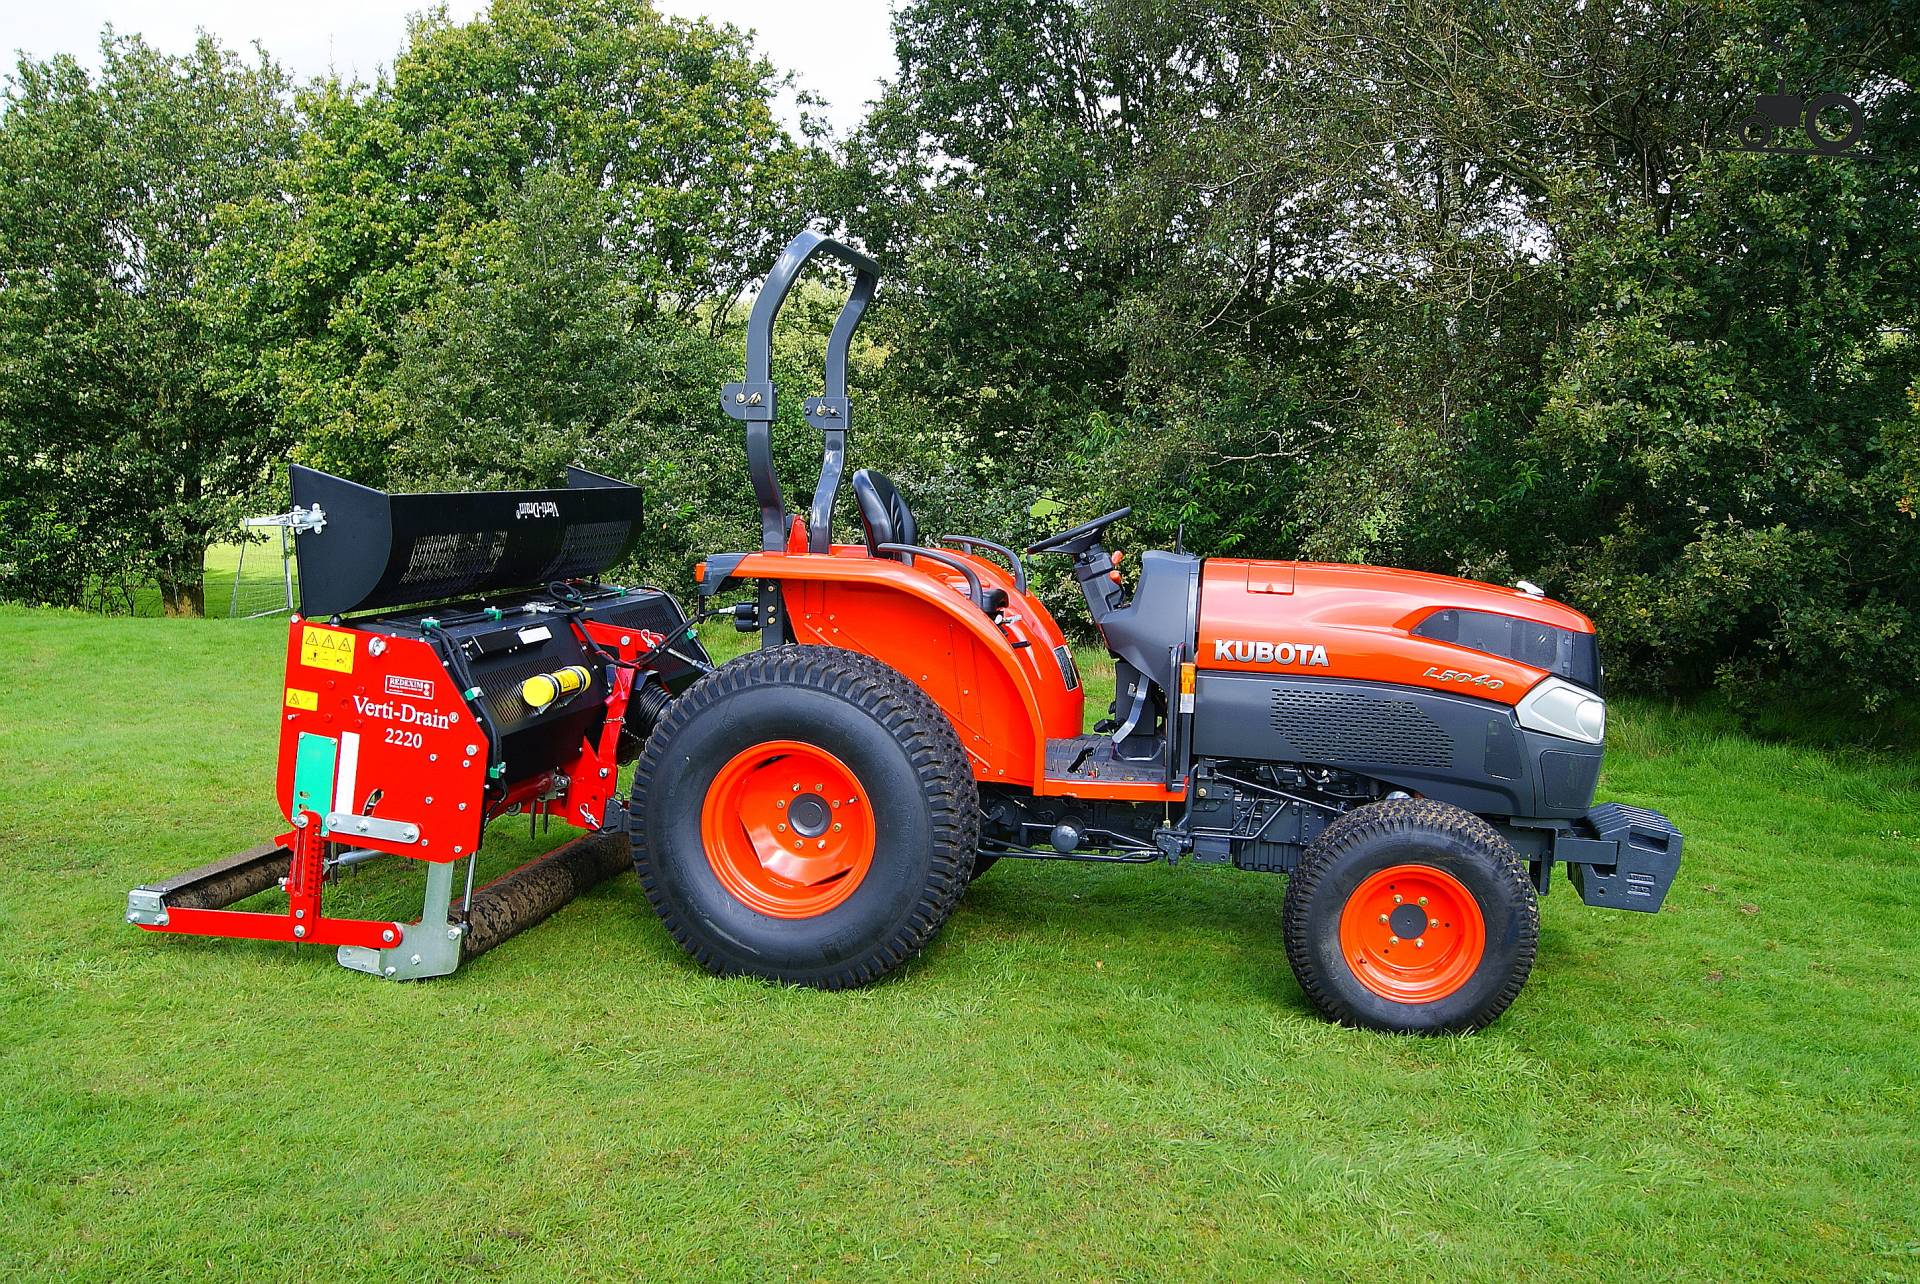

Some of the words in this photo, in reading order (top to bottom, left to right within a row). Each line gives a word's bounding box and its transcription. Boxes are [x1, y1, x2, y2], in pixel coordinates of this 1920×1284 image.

[1215, 639, 1330, 667] KUBOTA
[389, 677, 424, 690] REDEXIM
[1422, 666, 1504, 690] L5040
[384, 727, 423, 749] 2220
